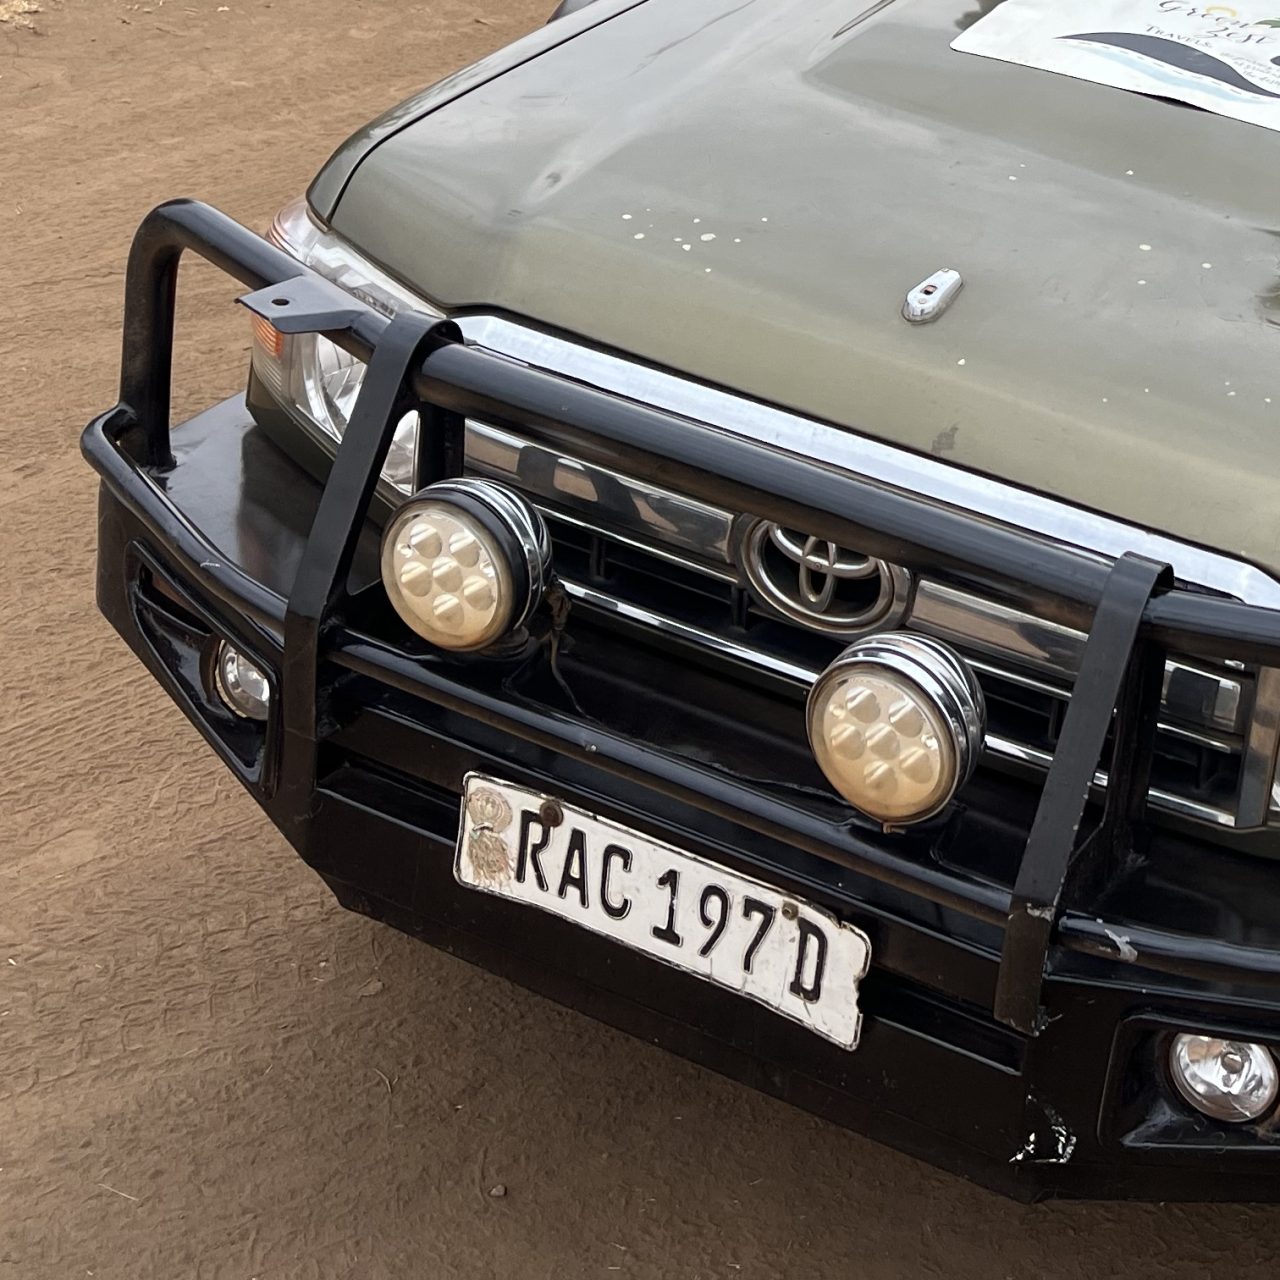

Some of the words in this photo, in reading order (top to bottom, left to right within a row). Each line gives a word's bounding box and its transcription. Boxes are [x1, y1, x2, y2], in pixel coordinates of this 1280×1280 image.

[514, 809, 632, 921] RAC
[650, 868, 777, 975] 197
[789, 915, 829, 1005] D
